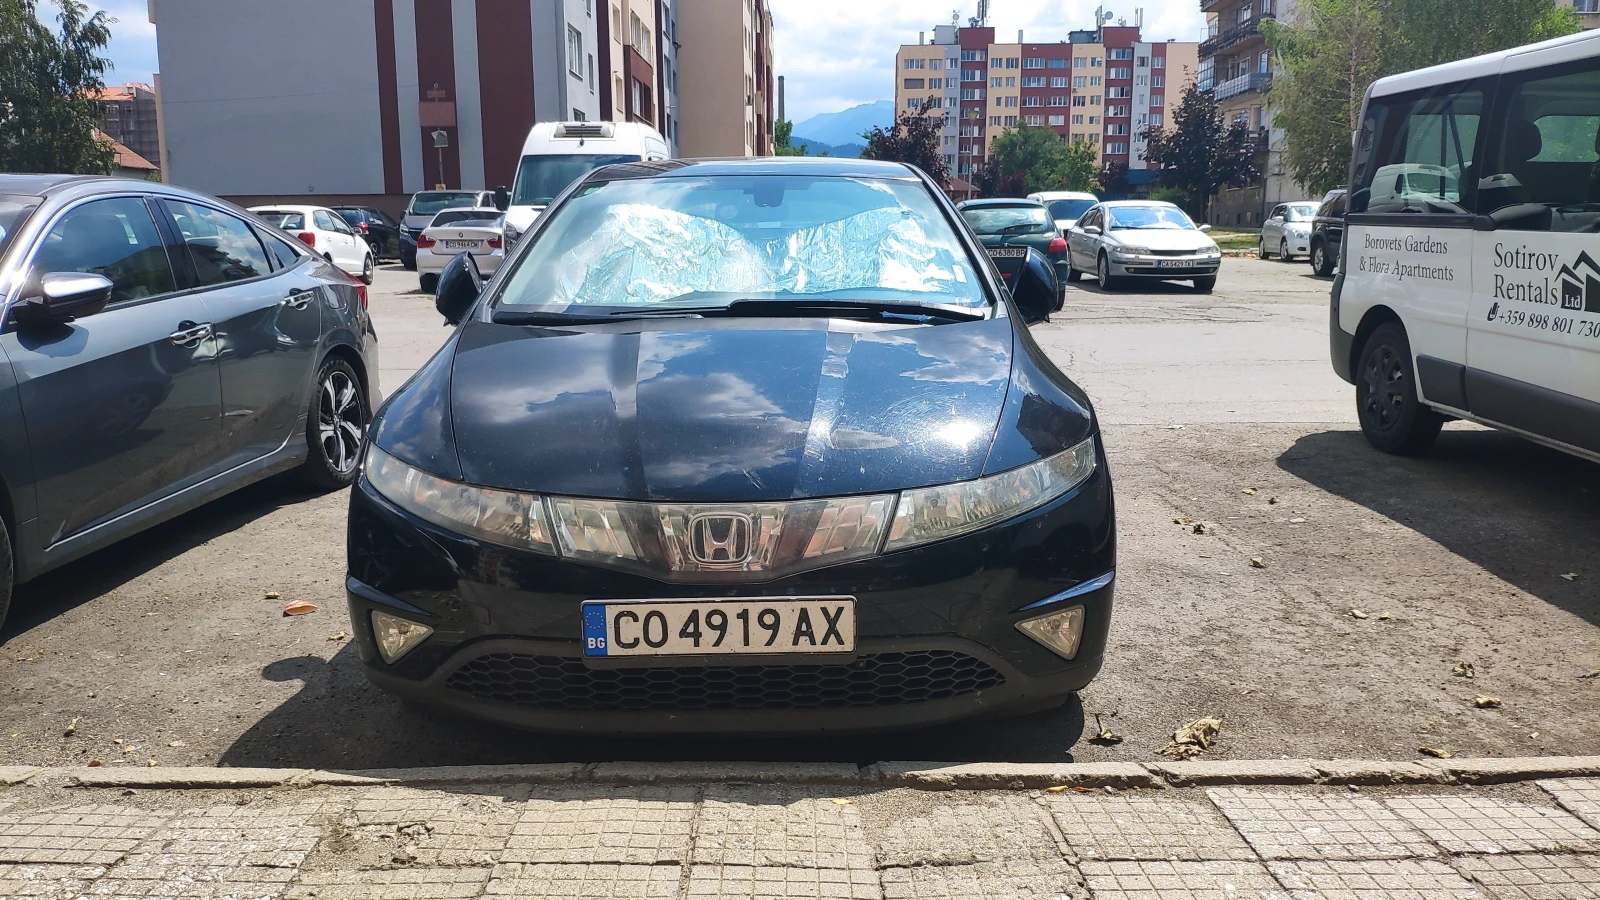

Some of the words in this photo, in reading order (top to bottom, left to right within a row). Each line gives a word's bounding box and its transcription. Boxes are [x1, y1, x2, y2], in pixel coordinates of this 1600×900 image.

[999, 249, 1015, 257] 6380
[1364, 233, 1402, 251] Borovets
[1405, 235, 1448, 254] Gardens
[1359, 256, 1367, 272] &
[1368, 256, 1390, 274] Flora
[1391, 259, 1454, 281] Apartments
[1493, 242, 1559, 271] Sotirov
[1492, 274, 1558, 305] Rentals
[1564, 294, 1581, 309] Ltd
[1498, 310, 1526, 327] +359
[1527, 313, 1550, 330] 898
[1551, 316, 1573, 334] 801
[1577, 320, 1600, 338] 730
[613, 610, 669, 649] CO
[678, 608, 781, 648] 4919
[791, 606, 845, 646] AX
[587, 637, 606, 649] BG
